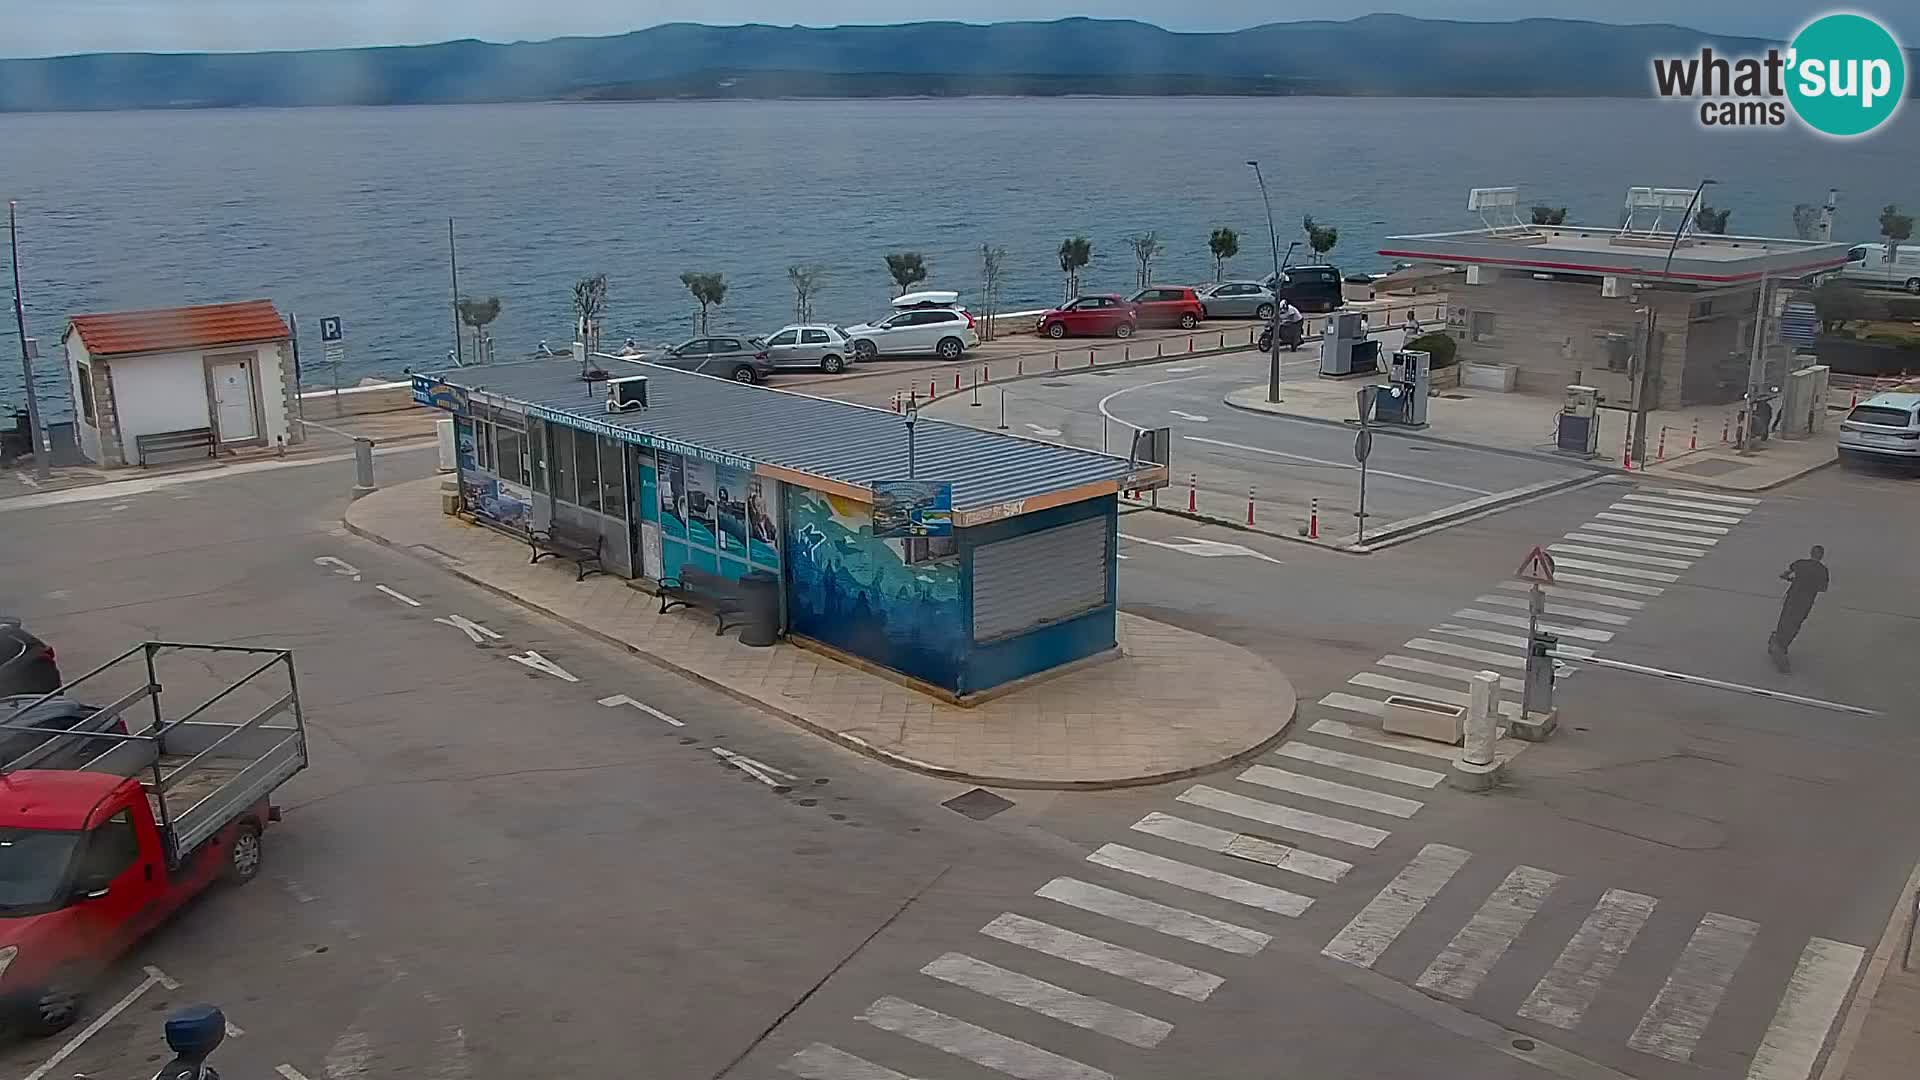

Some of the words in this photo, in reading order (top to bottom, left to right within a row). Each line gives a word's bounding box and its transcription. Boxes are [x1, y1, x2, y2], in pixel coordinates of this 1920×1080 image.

[325, 320, 337, 337] P
[611, 427, 641, 443] POSTAJA
[651, 438, 665, 449] BUS
[666, 442, 697, 457] STATION
[699, 449, 724, 463] TICKET
[725, 456, 752, 471] OFFICE
